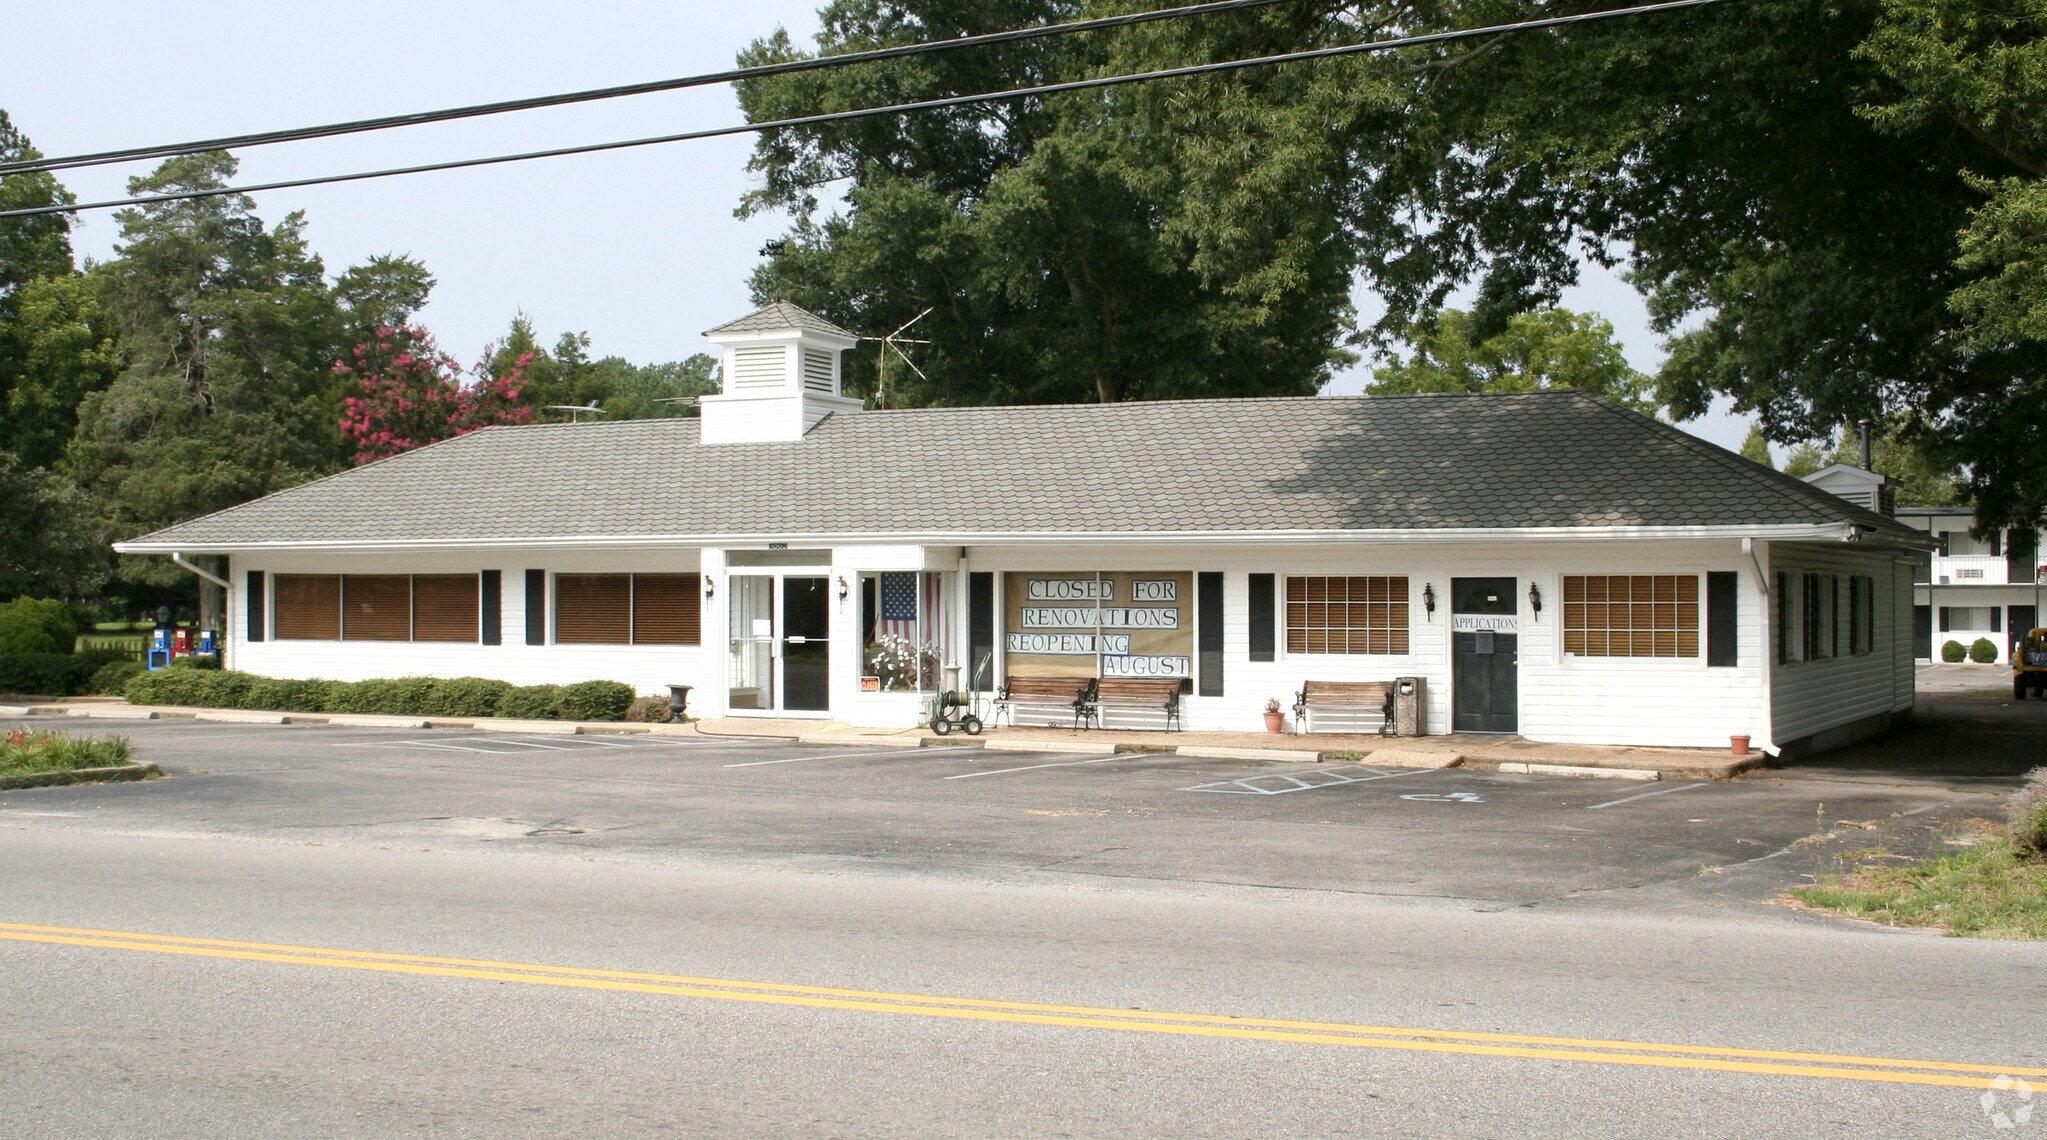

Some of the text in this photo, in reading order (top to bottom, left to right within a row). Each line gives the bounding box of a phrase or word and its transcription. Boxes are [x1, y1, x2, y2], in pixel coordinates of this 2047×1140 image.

[1030, 581, 1175, 599] CLOSED FOR
[1024, 609, 1177, 626] RENOVATIONS
[1007, 634, 1128, 652] REOPENING
[1105, 657, 1188, 675] AUGUST
[861, 681, 878, 690] CLOSED
